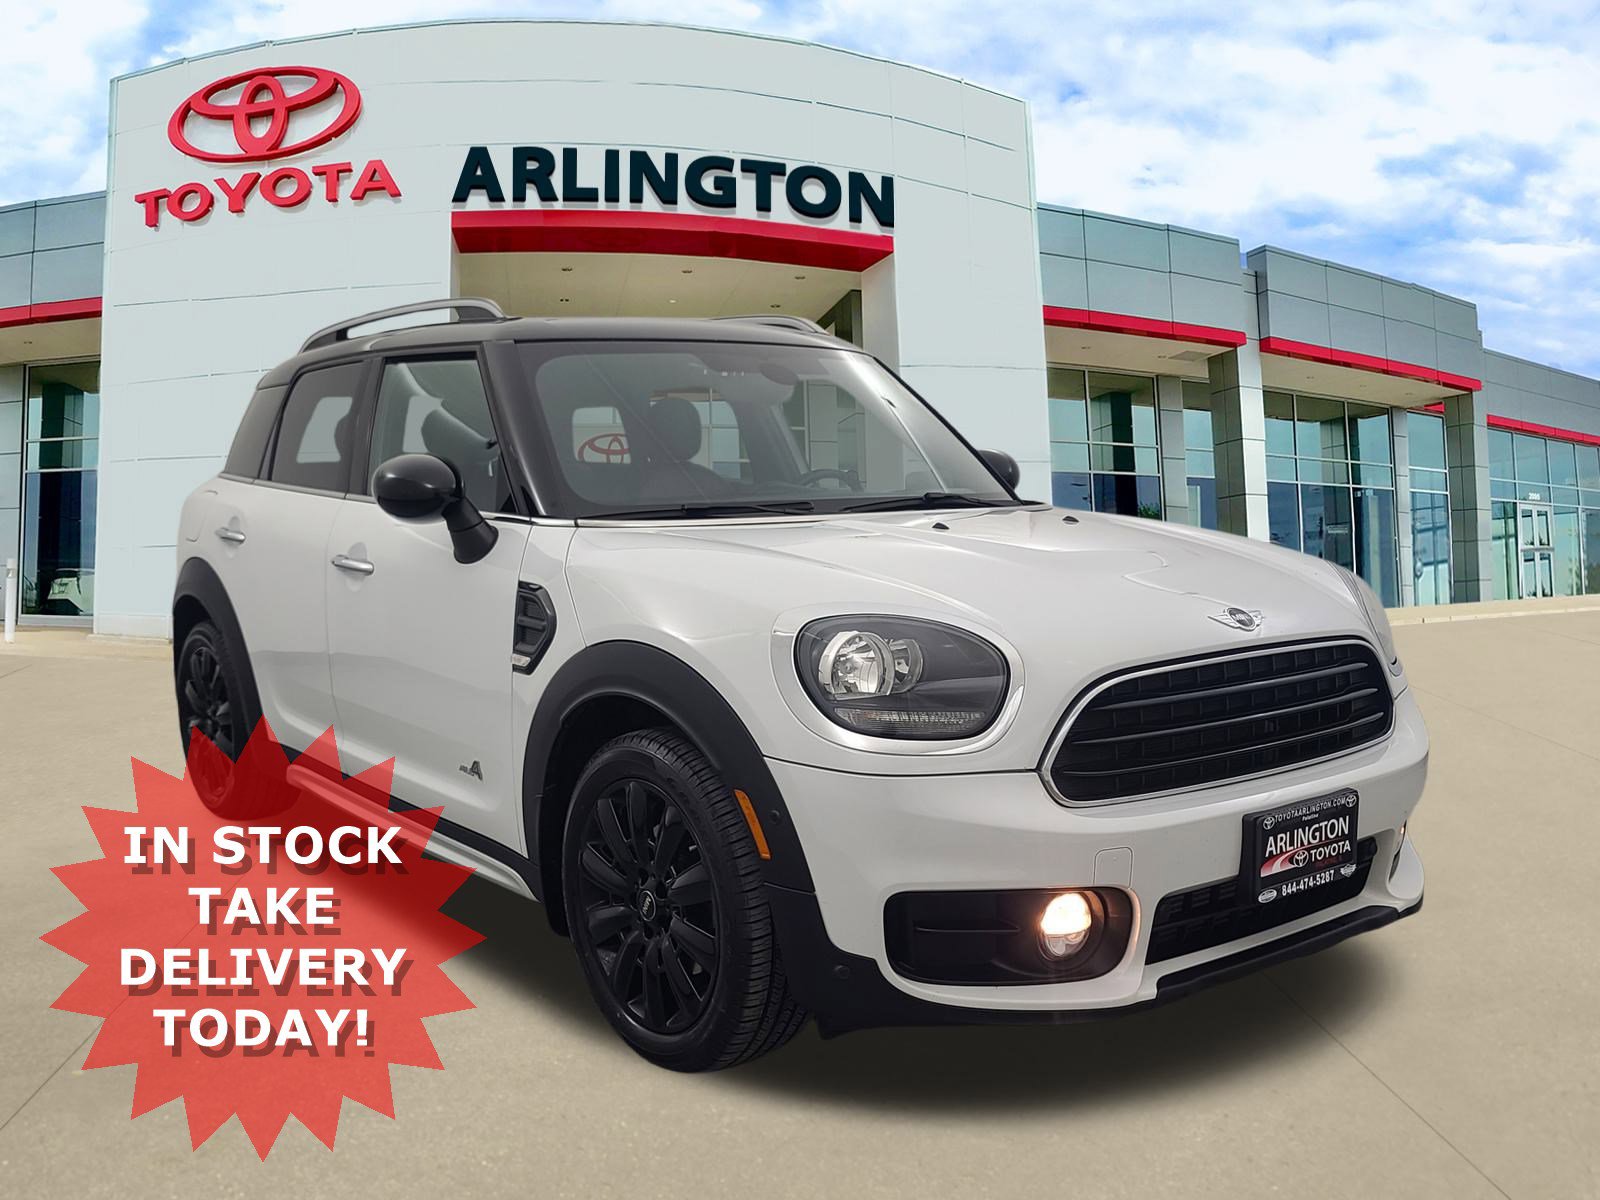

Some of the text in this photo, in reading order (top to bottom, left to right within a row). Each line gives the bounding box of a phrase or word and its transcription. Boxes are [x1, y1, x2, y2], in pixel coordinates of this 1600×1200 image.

[134, 159, 402, 228] TOYOTA
[451, 146, 895, 228] ARLINGTON
[1265, 815, 1350, 858] ARLINGTON
[1310, 840, 1352, 862] TOYOTA
[1281, 869, 1335, 897] 844-474-5287
